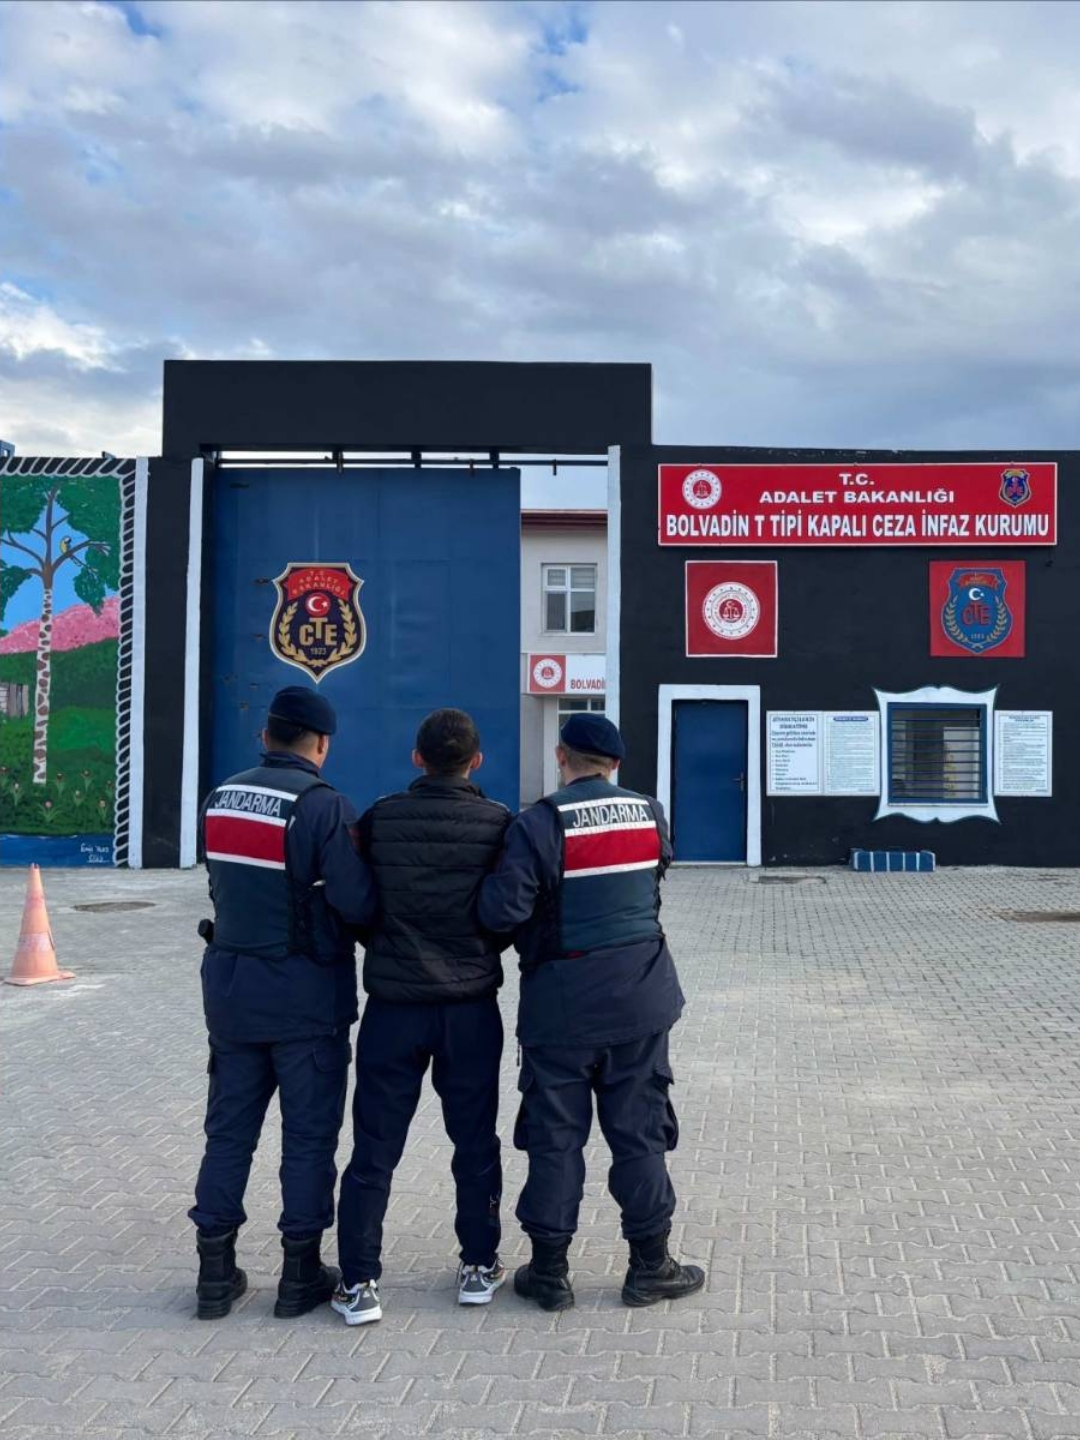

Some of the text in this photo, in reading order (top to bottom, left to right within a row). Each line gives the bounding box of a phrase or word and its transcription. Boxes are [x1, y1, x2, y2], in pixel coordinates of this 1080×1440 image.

[839, 473, 874, 485] T.C.
[760, 488, 954, 503] ADALET BAKANLIĞI
[667, 509, 1049, 537] BOLVADİN T TİPİ KAPALI CEZA İNFAZ KURUMU
[298, 617, 337, 645] CTE
[570, 678, 606, 690] BOLVADİ
[214, 790, 281, 817] JANDARMA
[573, 804, 649, 828] JANDARMA
